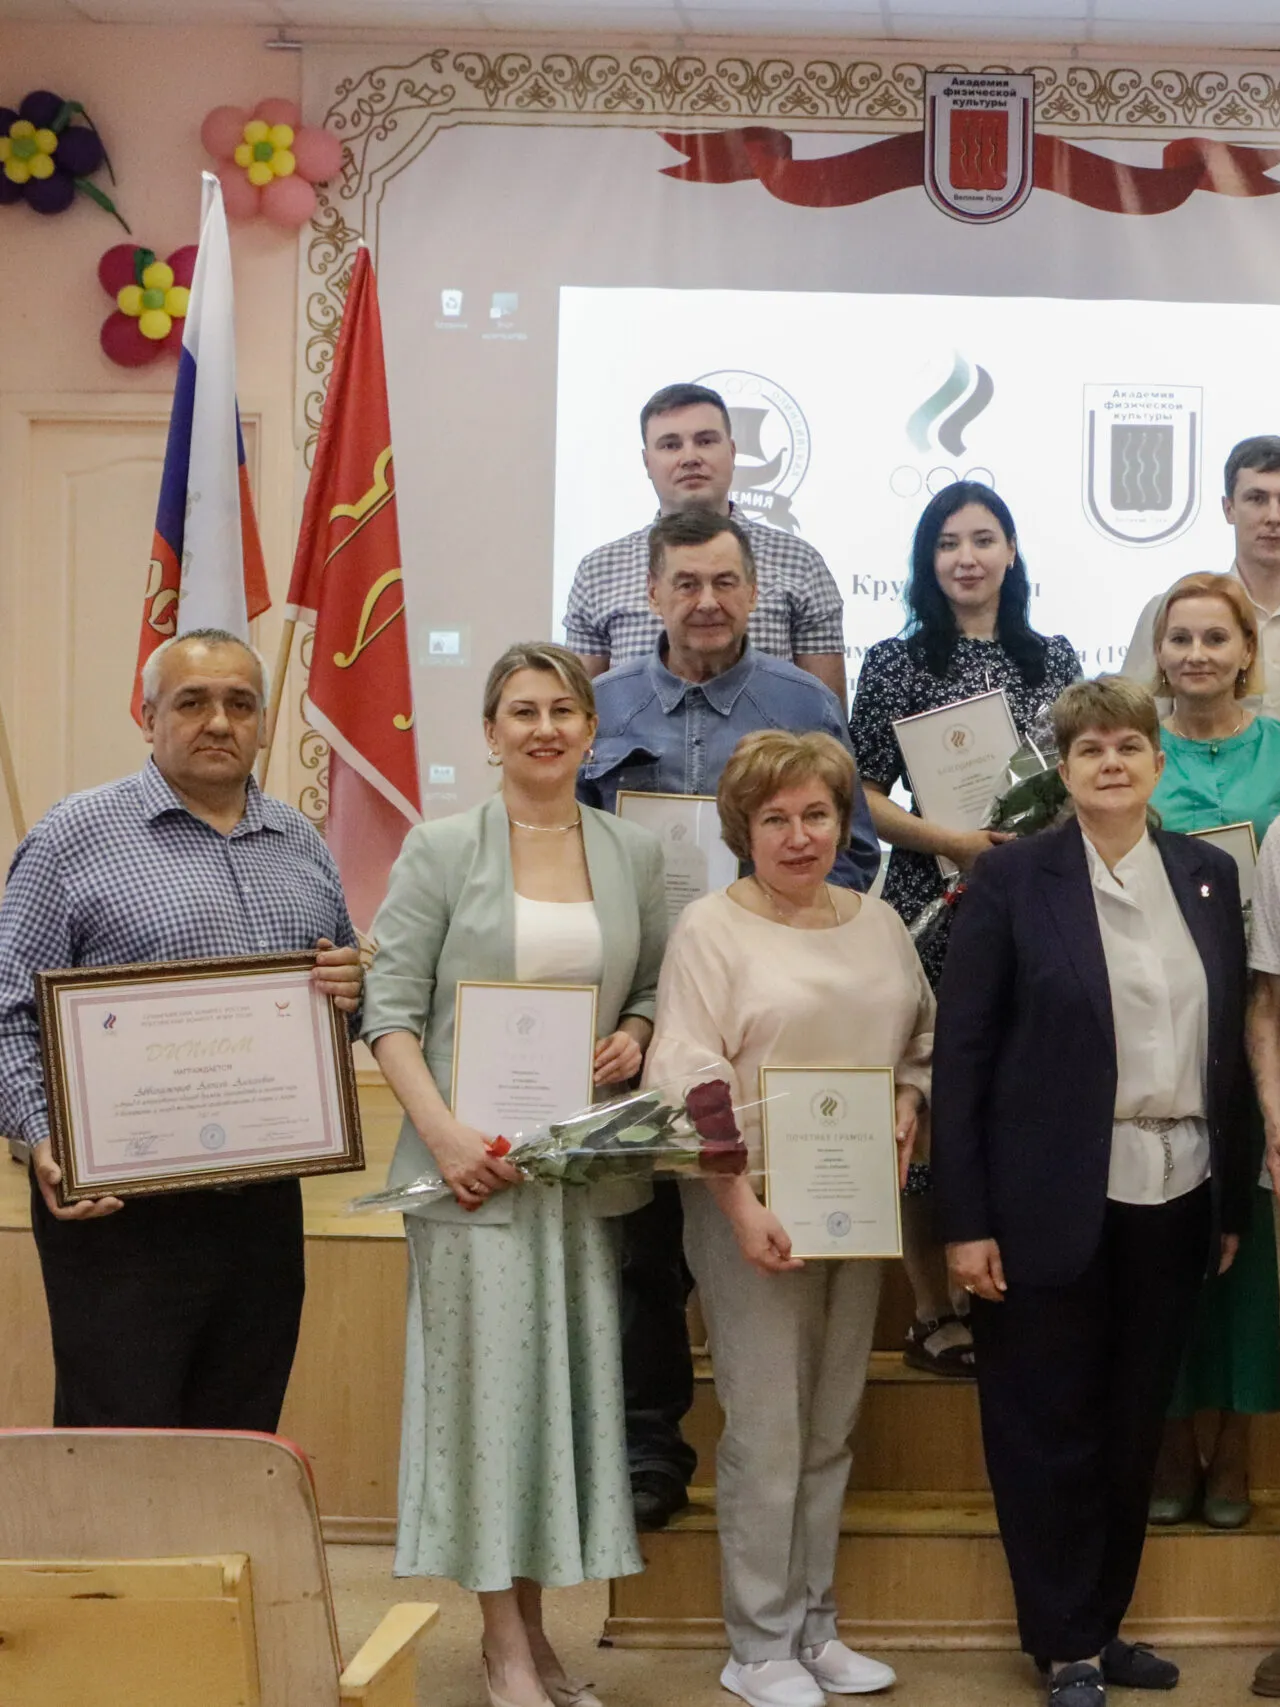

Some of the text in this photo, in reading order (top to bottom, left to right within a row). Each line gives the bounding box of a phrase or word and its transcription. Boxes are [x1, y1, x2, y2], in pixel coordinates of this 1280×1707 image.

[951, 77, 1010, 88] Академия
[943, 88, 1017, 98] физической
[952, 99, 1007, 108] культуры
[1112, 389, 1174, 399] Академия
[1113, 412, 1173, 422] культуры
